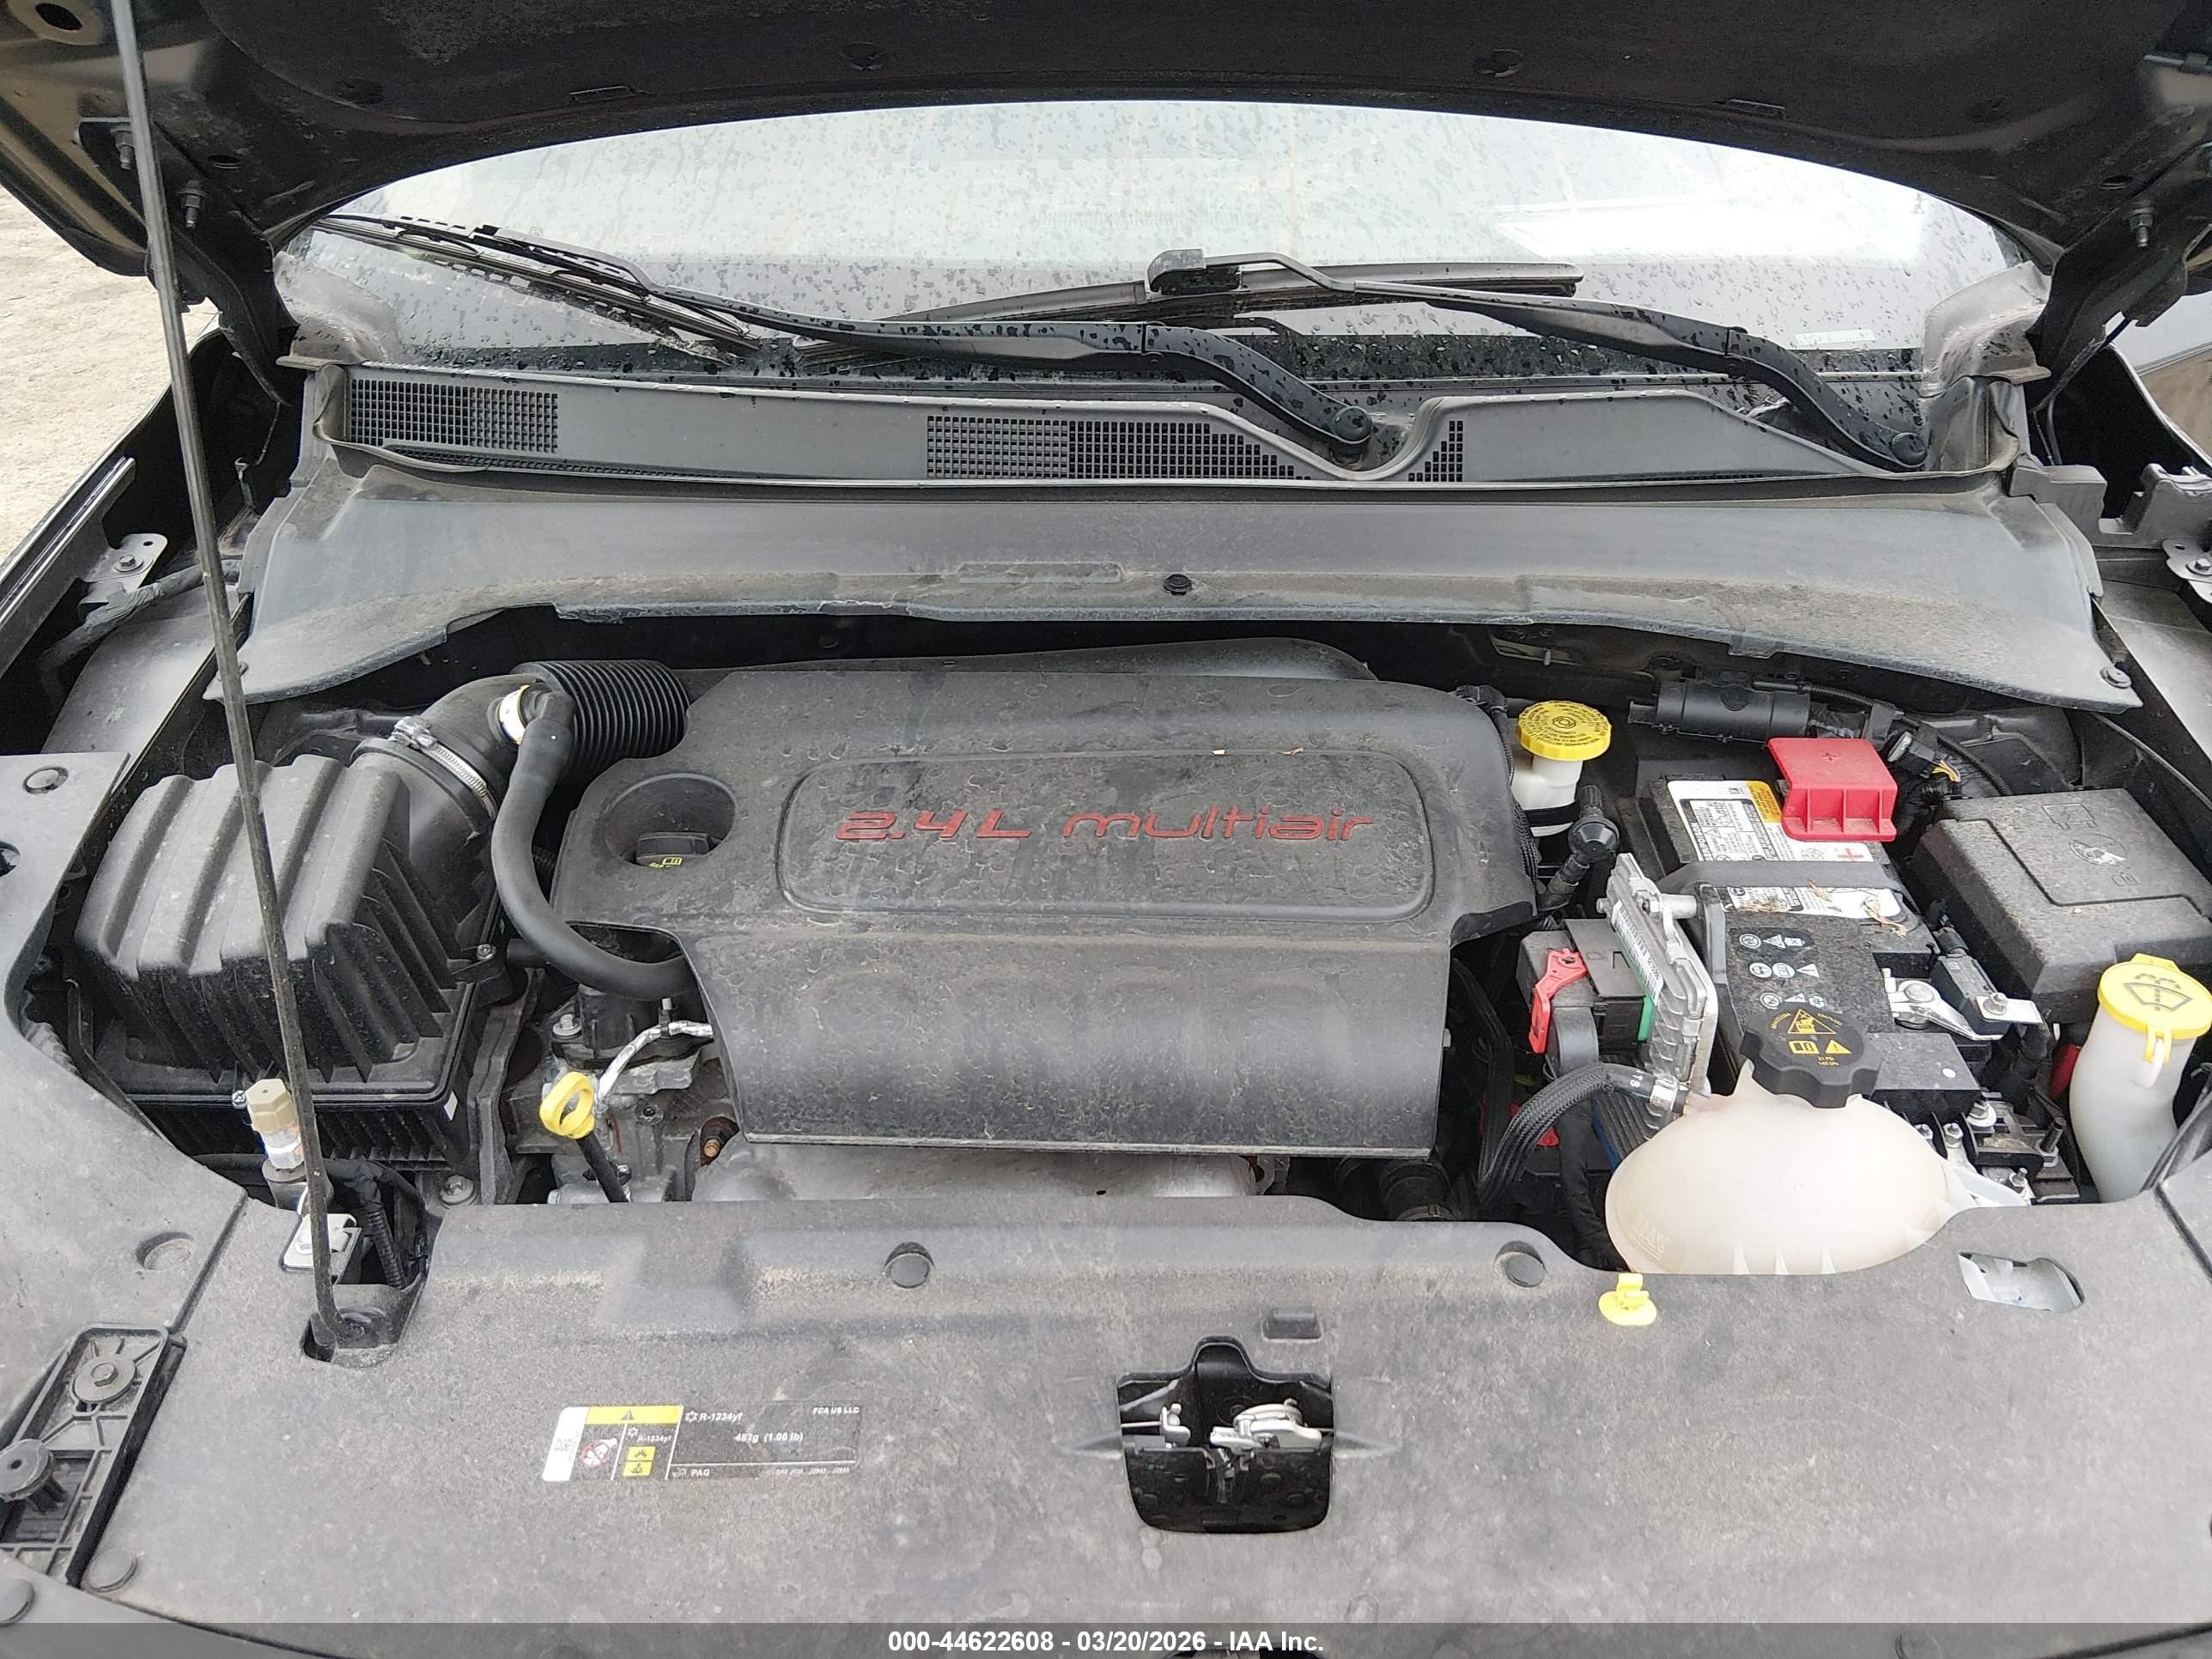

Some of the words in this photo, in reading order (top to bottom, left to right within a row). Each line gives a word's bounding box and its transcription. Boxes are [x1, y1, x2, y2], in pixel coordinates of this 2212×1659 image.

[835, 809, 1032, 842] 2.4L
[1063, 805, 1374, 842] multiair
[699, 1412, 744, 1423] R-1234yf
